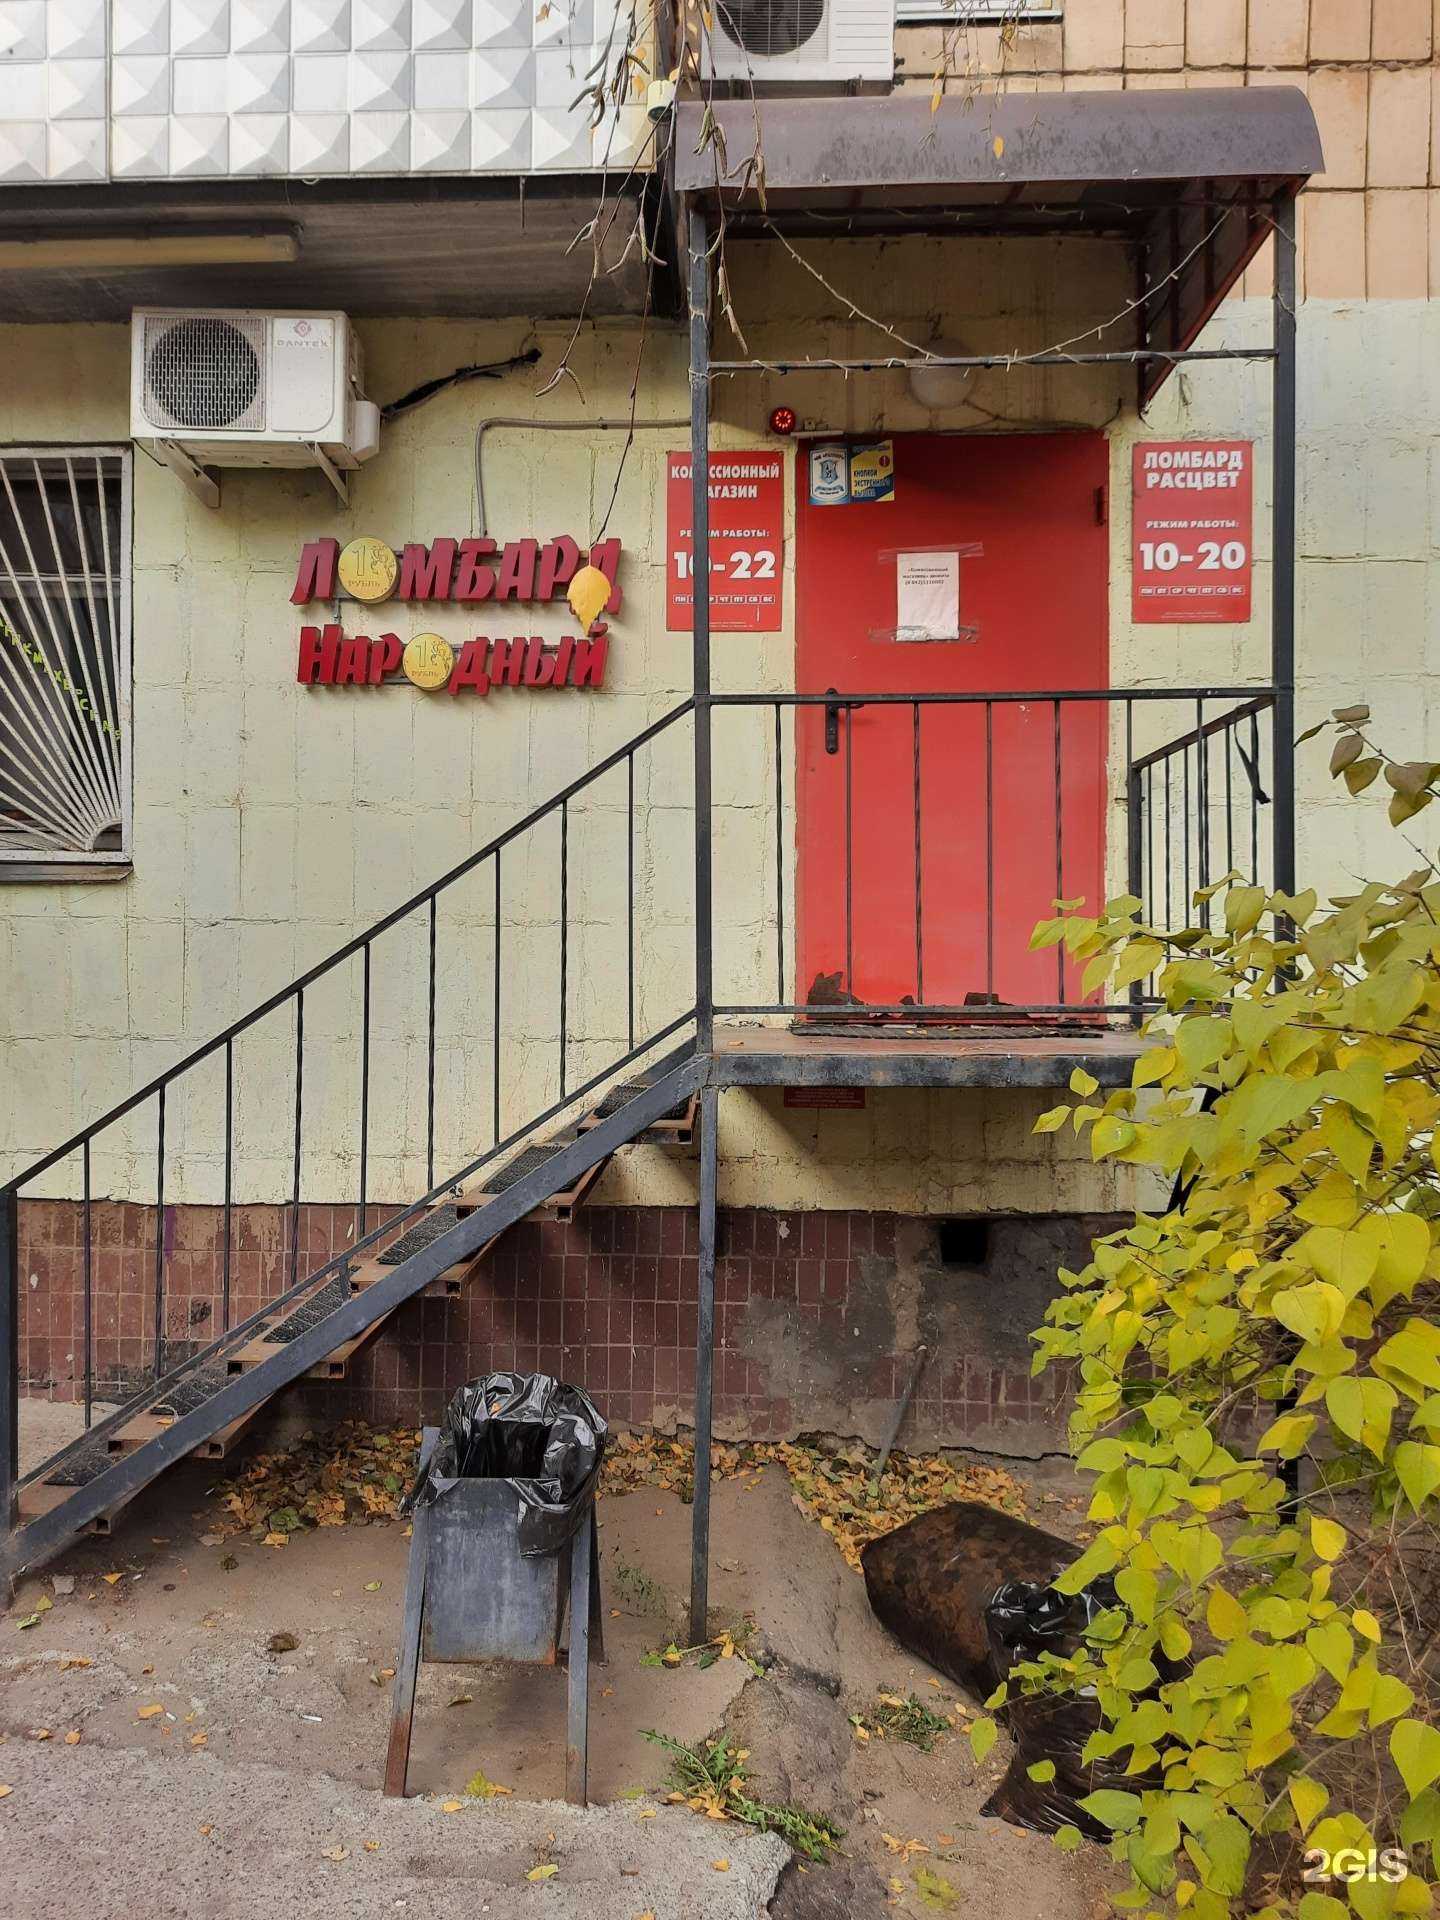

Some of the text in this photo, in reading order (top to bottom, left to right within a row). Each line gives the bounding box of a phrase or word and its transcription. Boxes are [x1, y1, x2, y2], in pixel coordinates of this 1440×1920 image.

[1143, 450, 1244, 470] ЛОМБАРД
[671, 462, 780, 478] КОССИОННЫЙ
[1146, 471, 1240, 490] РАСЦВЕТ
[707, 485, 758, 498] АГАЗИН
[1146, 520, 1188, 529] РЕЖИМ
[722, 529, 770, 537] РАБОТЫ:
[1139, 541, 1246, 570] 10-20
